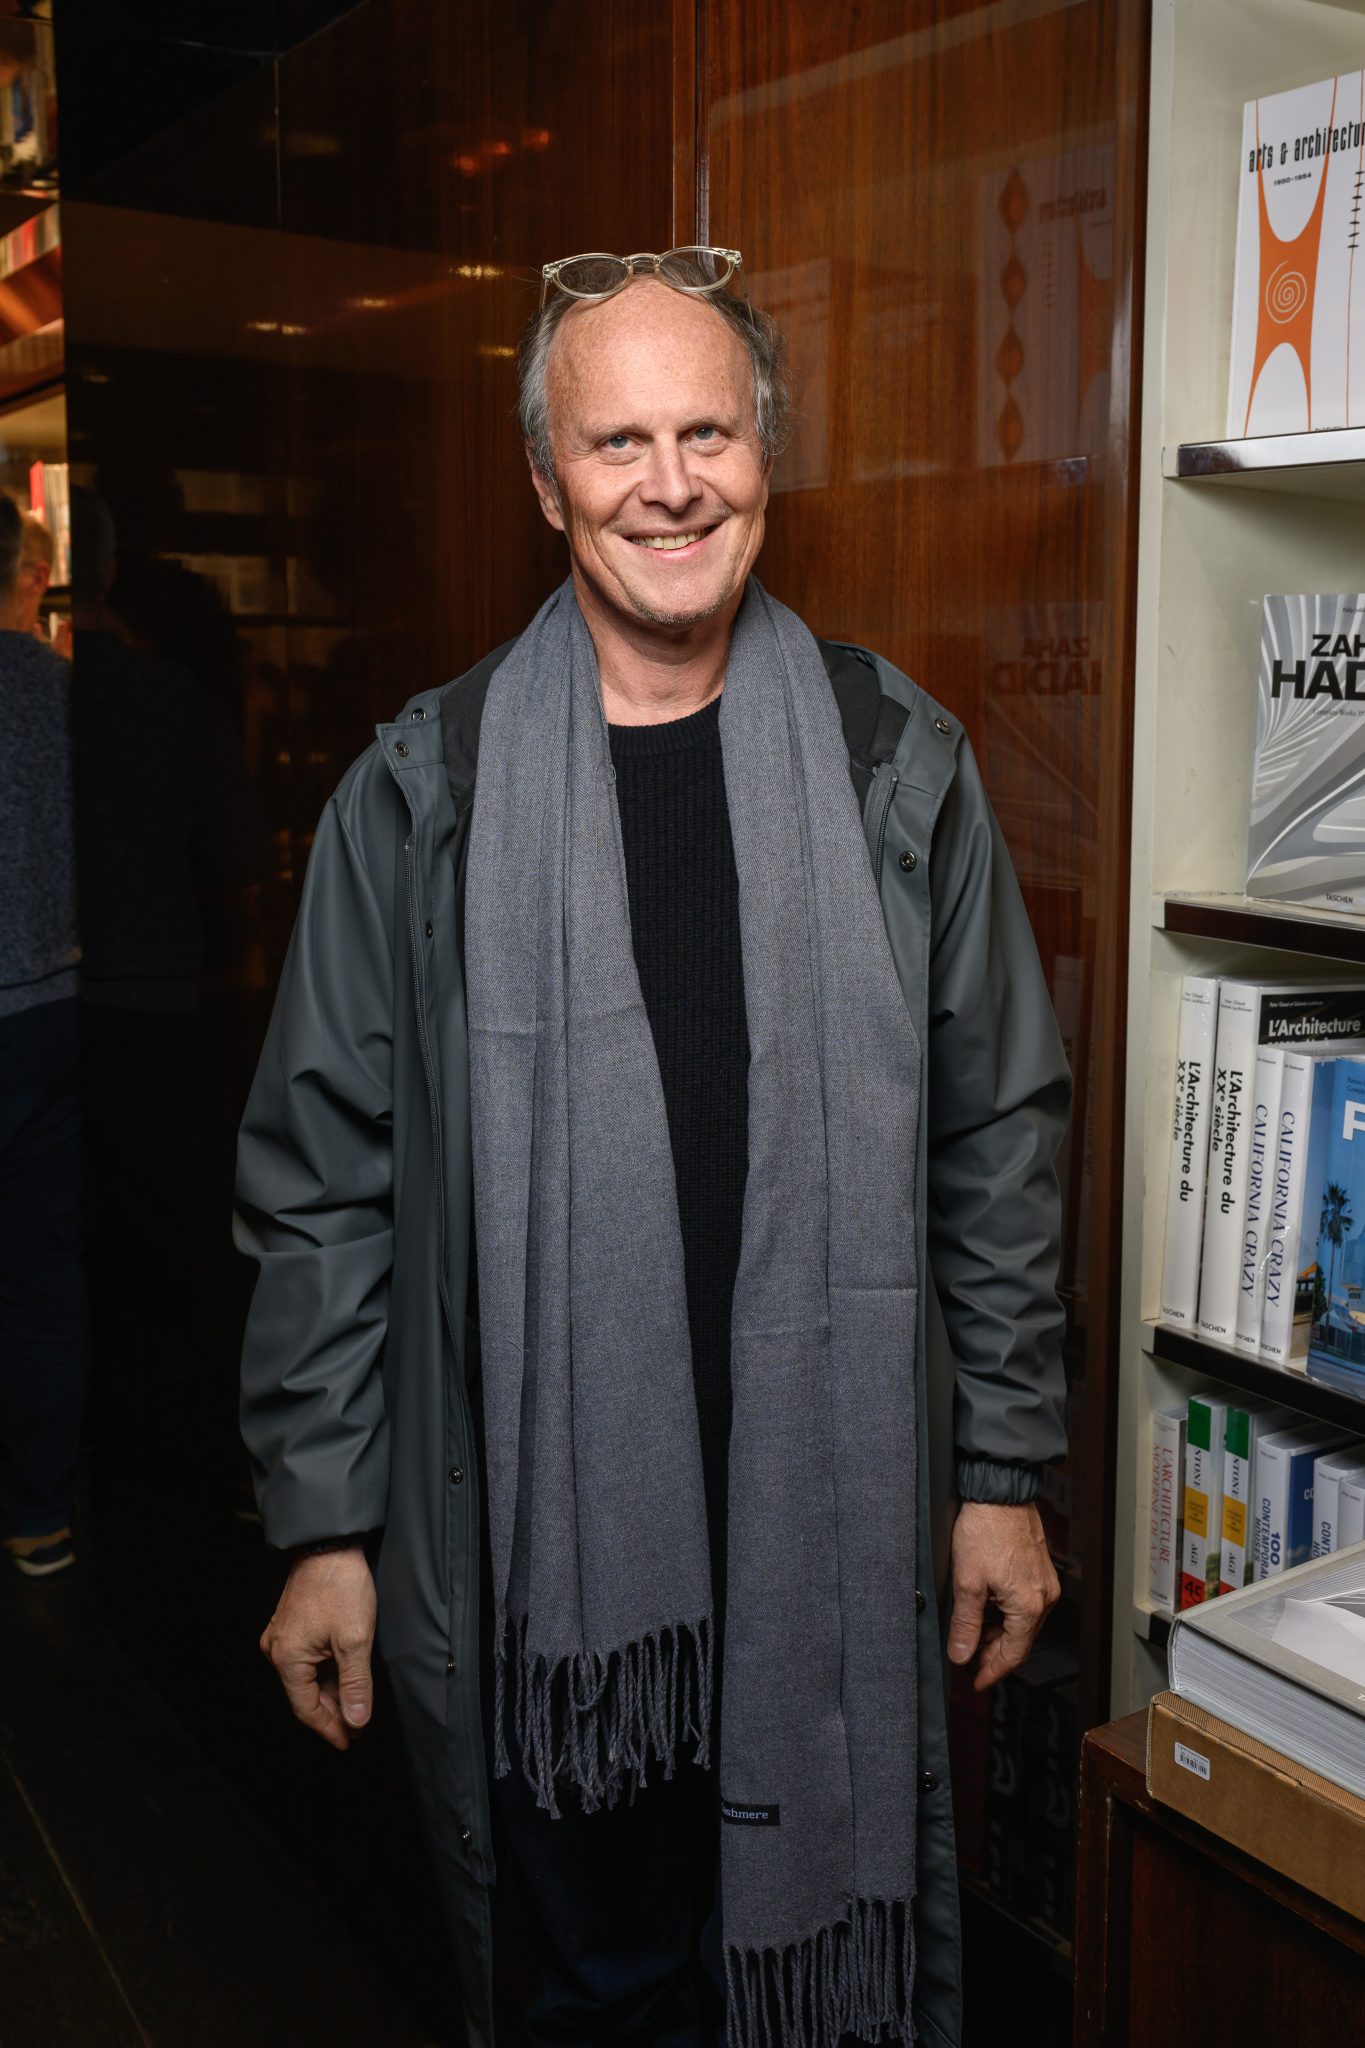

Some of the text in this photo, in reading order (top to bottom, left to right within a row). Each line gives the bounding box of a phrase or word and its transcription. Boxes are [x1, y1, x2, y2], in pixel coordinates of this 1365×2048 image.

[1249, 143, 1273, 172] arts
[1280, 142, 1288, 165] &
[1269, 1016, 1361, 1037] L'Architecture
[1180, 1061, 1201, 1202] L'Architecture du
[1212, 1105, 1225, 1152] siècle
[1220, 1070, 1243, 1214] L'Architecture du
[1241, 1104, 1268, 1297] CALIFORNIA CRAZY
[1267, 1111, 1295, 1307] CALIFORNIA CRAZY
[1159, 1447, 1173, 1565] L'ARCHITECTURE
[1270, 1531, 1280, 1565] 100
